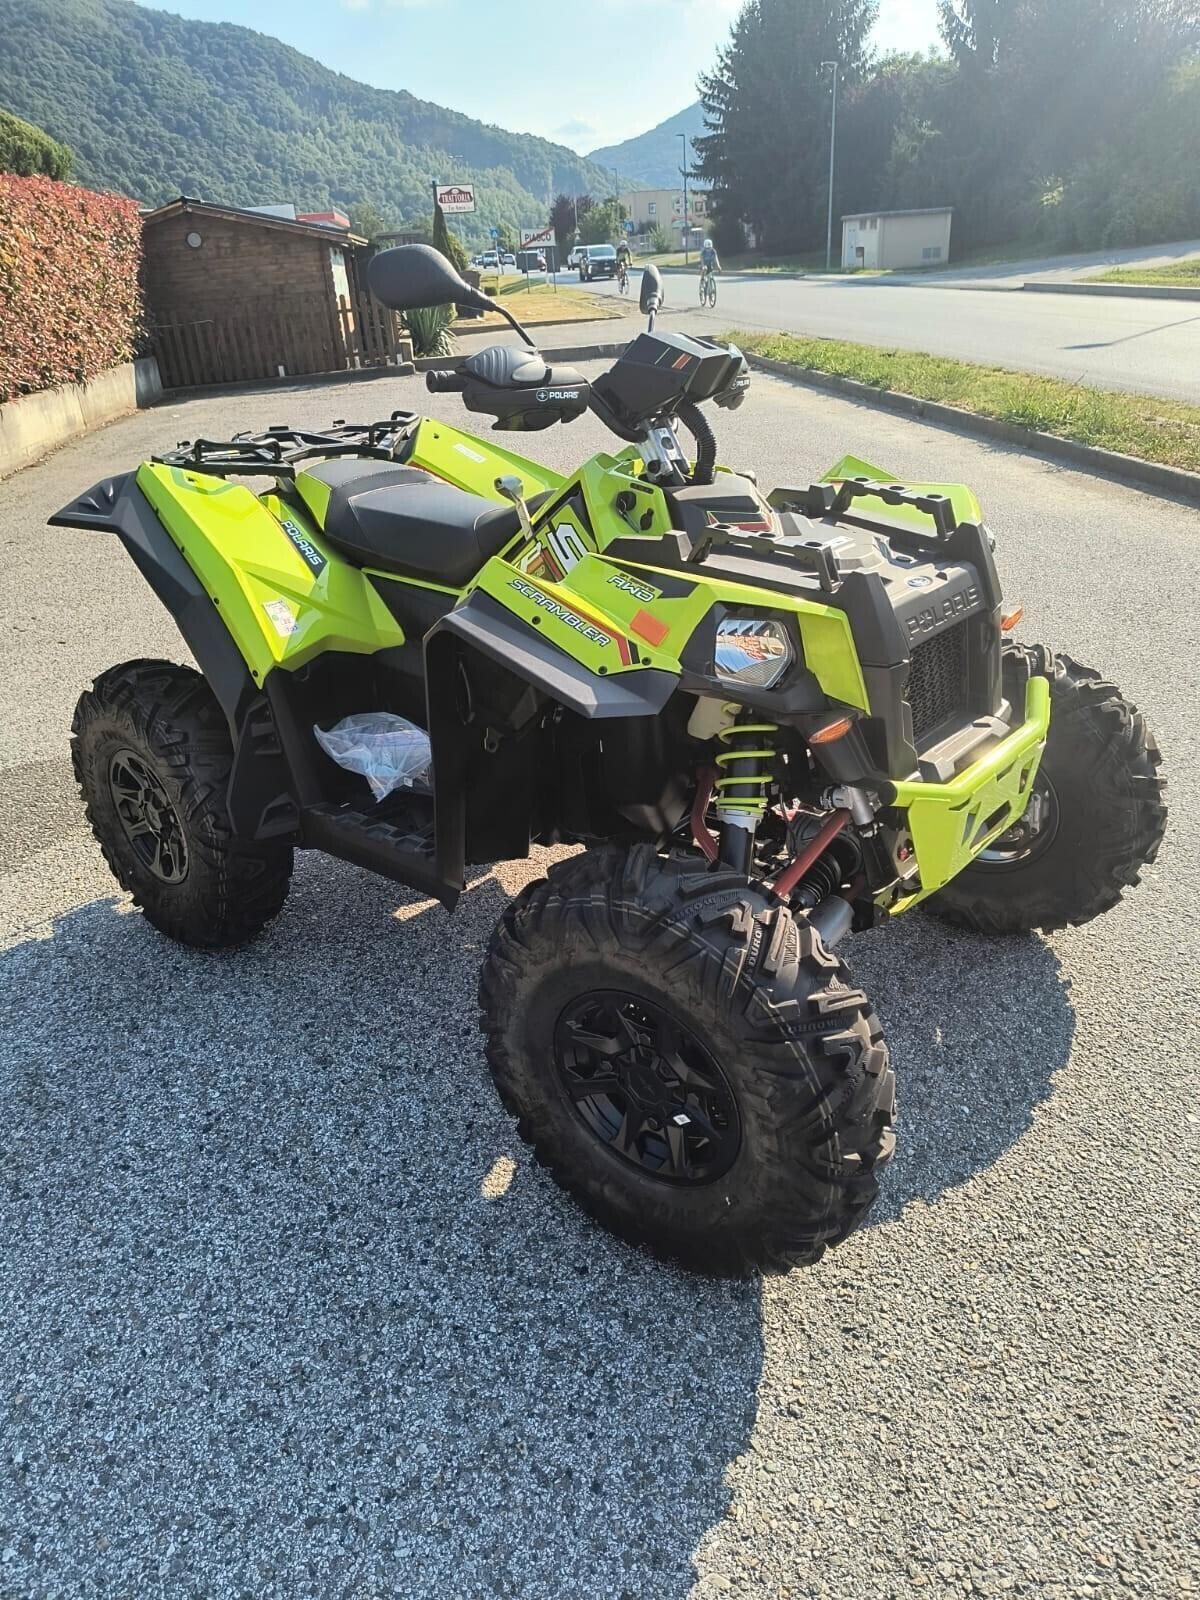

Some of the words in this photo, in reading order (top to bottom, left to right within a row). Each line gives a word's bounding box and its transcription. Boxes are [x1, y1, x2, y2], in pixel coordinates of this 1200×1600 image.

[524, 233, 552, 242] PIASCO
[549, 391, 579, 400] POLARIS
[281, 520, 323, 565] POLARIS
[606, 575, 655, 602] AWD
[507, 579, 611, 647] SCRAMBLER
[905, 584, 981, 641] POLARIS
[749, 930, 764, 968] DURO
